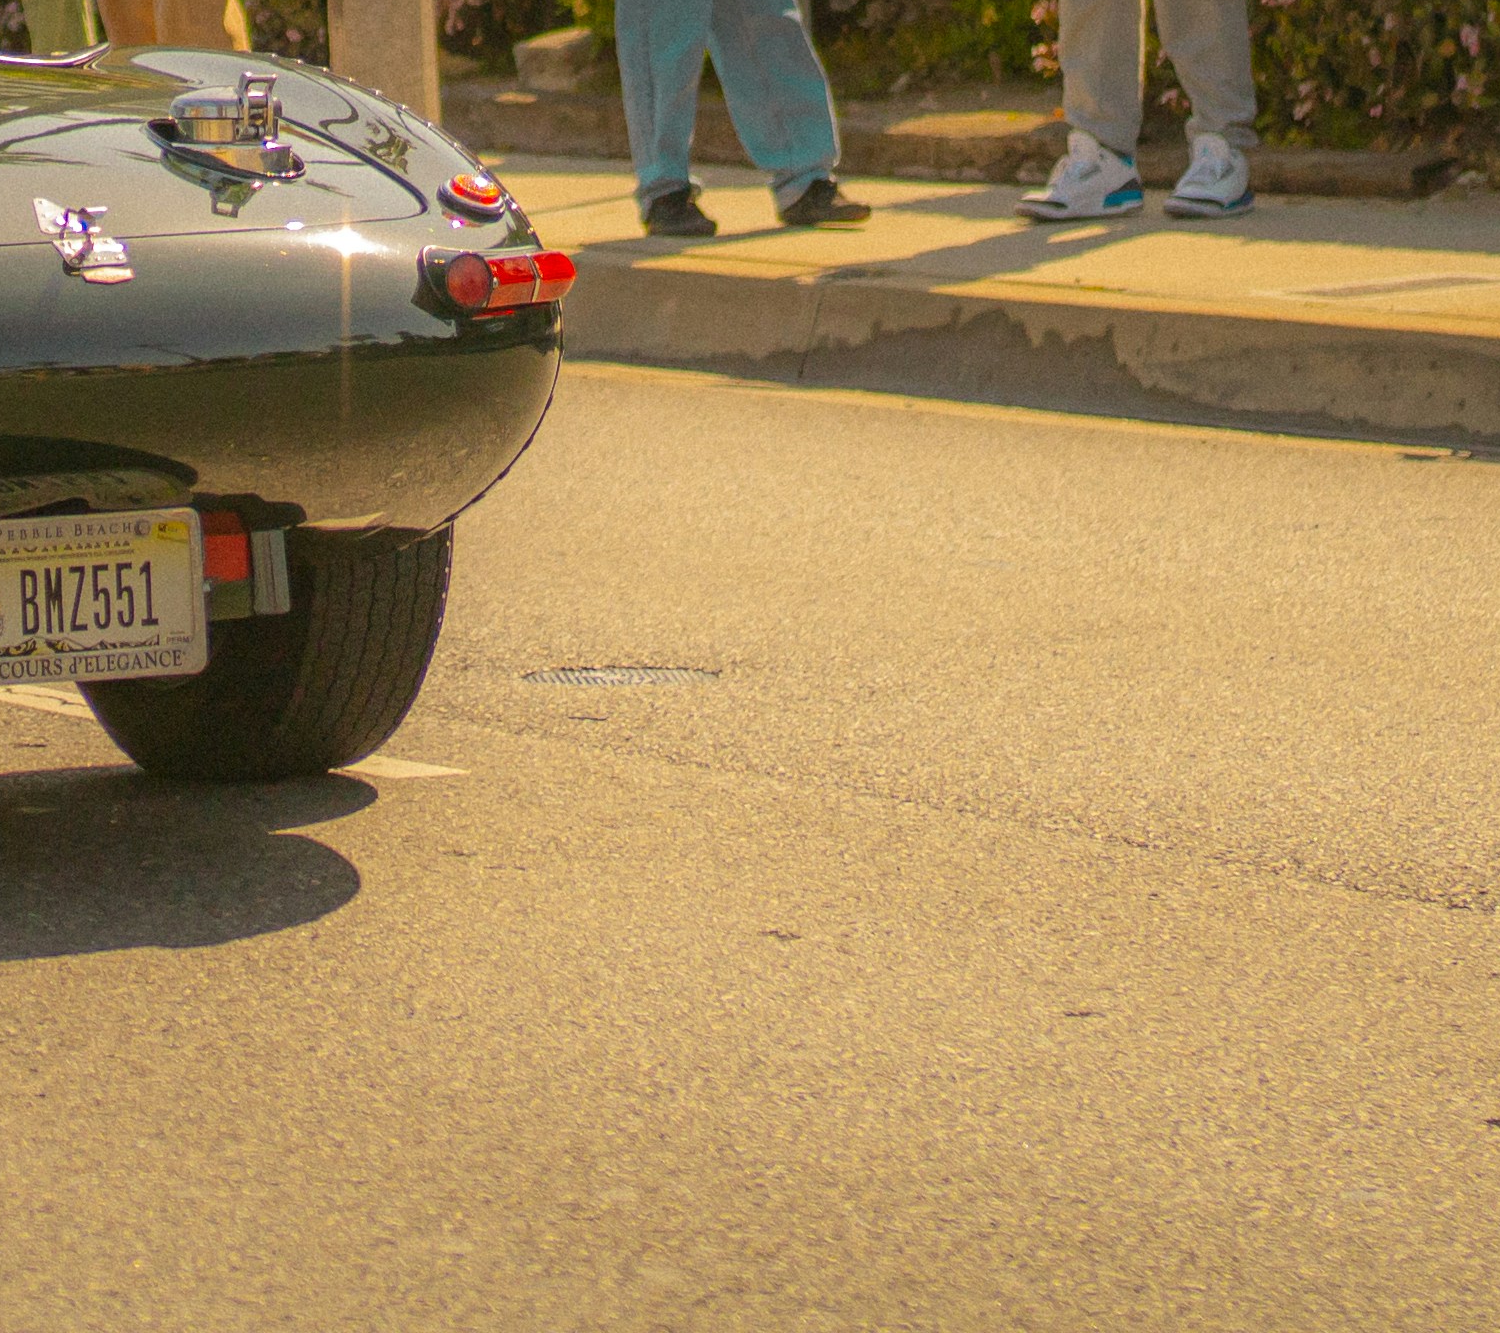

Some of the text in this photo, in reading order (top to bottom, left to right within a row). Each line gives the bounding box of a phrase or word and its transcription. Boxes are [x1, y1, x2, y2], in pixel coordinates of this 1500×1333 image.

[74, 521, 133, 537] BEACH
[20, 560, 159, 636] BMZ551
[69, 651, 183, 675] d'ELEGANCE
